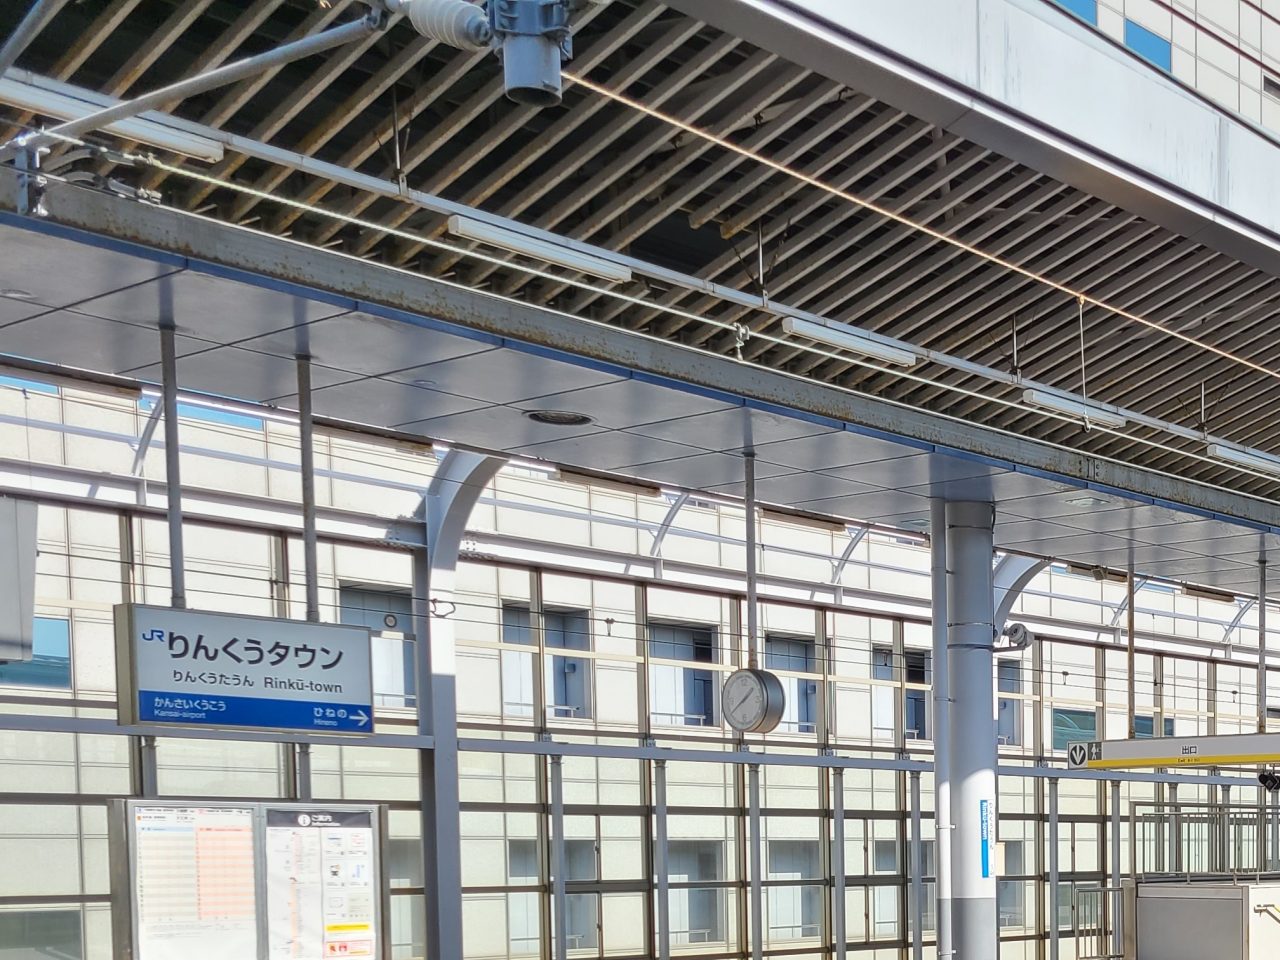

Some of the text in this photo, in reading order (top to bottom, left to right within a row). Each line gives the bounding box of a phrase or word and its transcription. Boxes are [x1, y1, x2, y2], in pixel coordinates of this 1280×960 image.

[142, 629, 166, 642] JR
[168, 631, 344, 670] りんくうタウン
[173, 669, 254, 687] りんくうたうん
[154, 697, 226, 711] かんさいくうこう
[313, 707, 347, 719] ひねの
[1182, 745, 1197, 755] 出口
